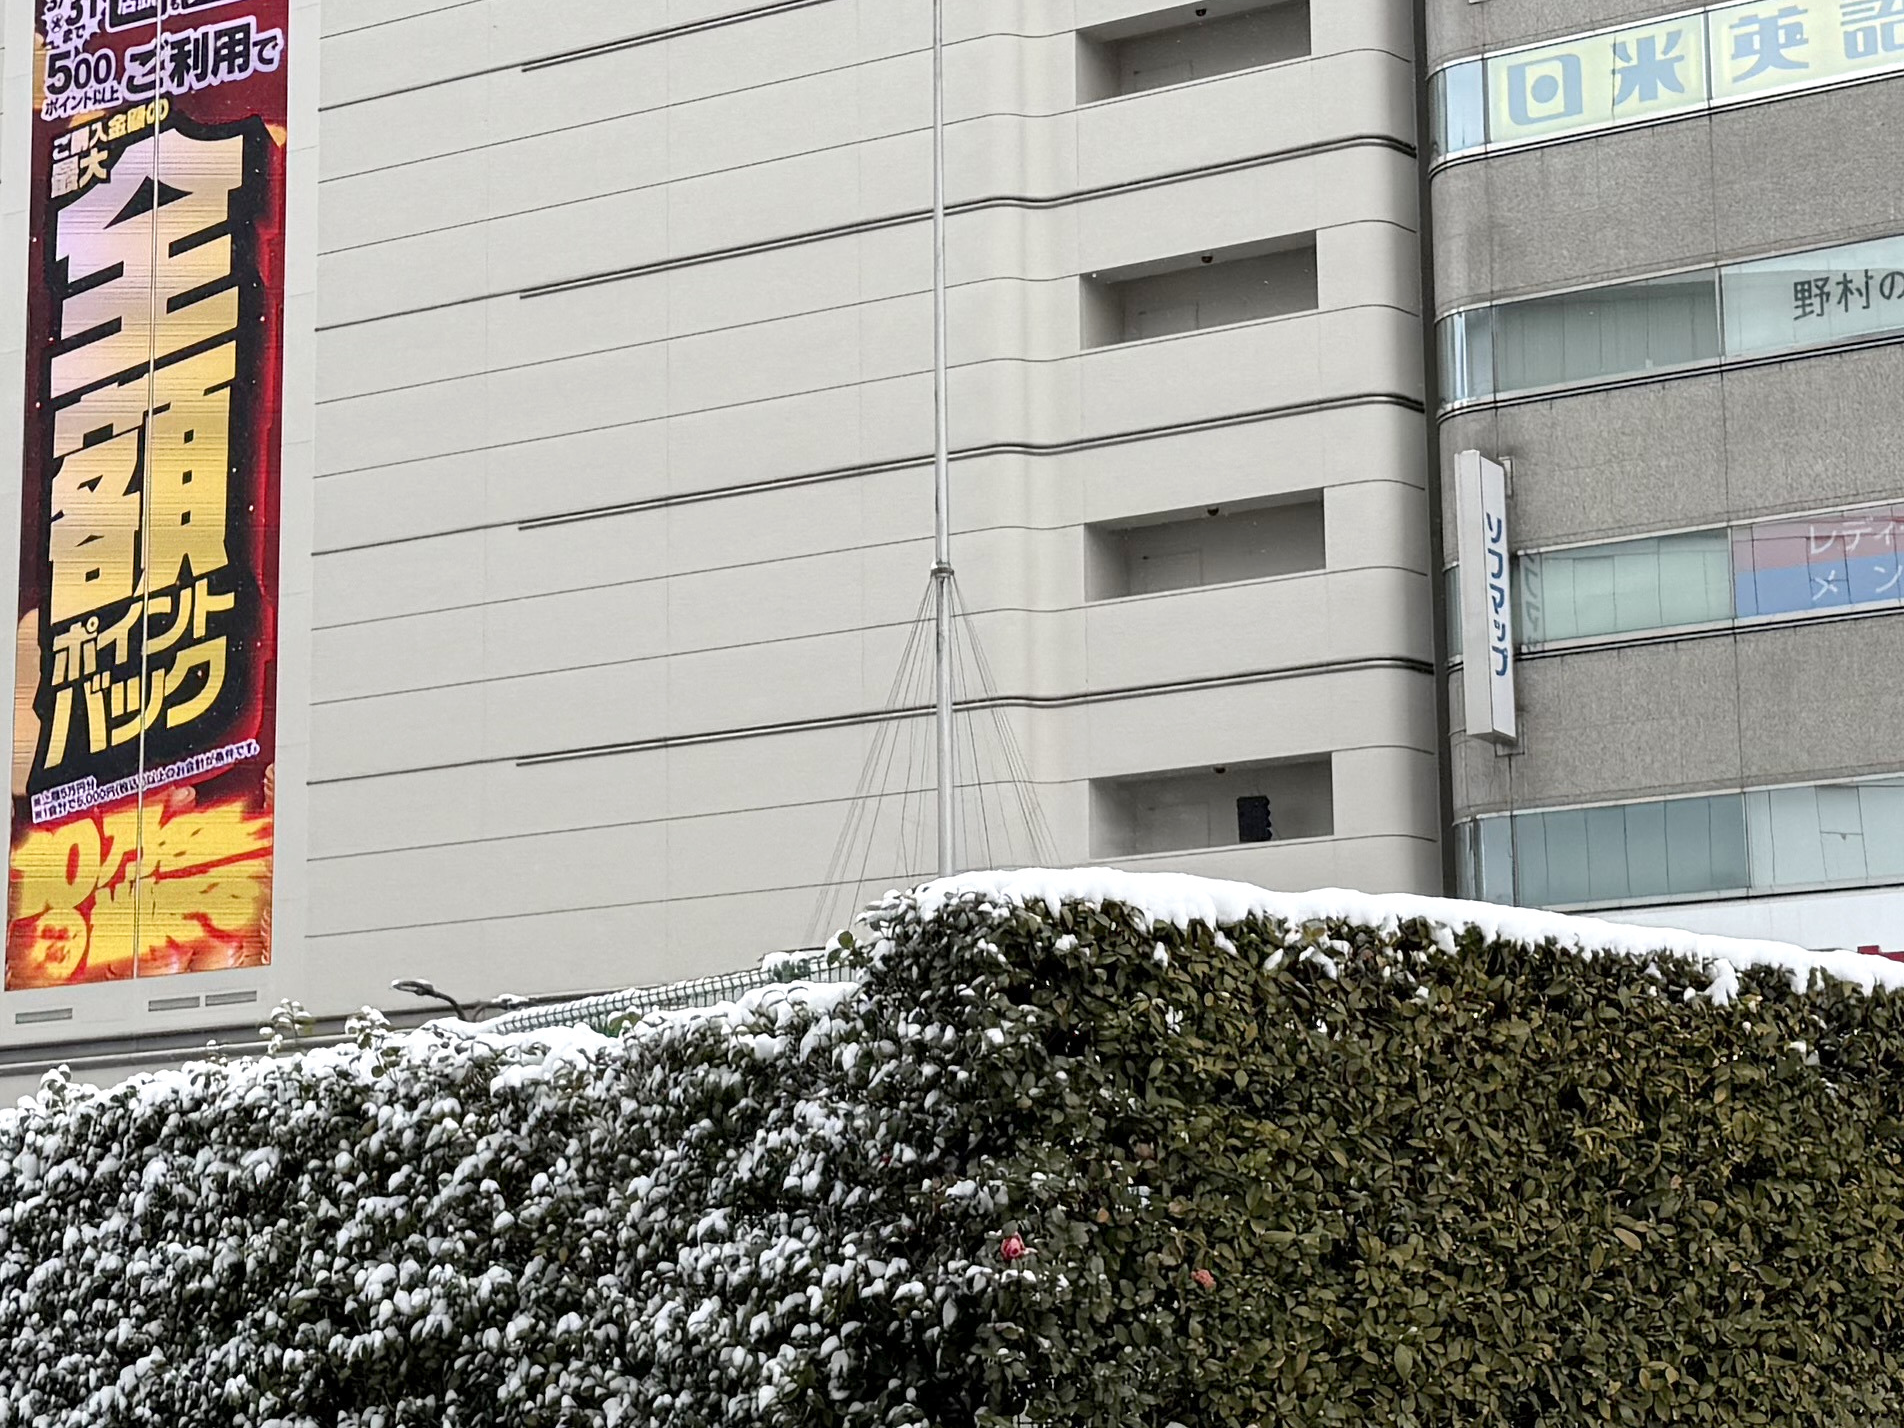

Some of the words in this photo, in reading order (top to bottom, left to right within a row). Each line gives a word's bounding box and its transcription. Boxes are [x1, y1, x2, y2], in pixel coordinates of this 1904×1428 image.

[46, 82, 120, 115] ポイント以上
[47, 49, 112, 96] 500
[127, 20, 280, 96] ご利用で
[51, 149, 108, 199] 最大
[49, 127, 245, 627] 全額
[51, 577, 236, 688] ポイント
[1486, 512, 1509, 677] ソフマップ
[44, 634, 226, 770] バック
